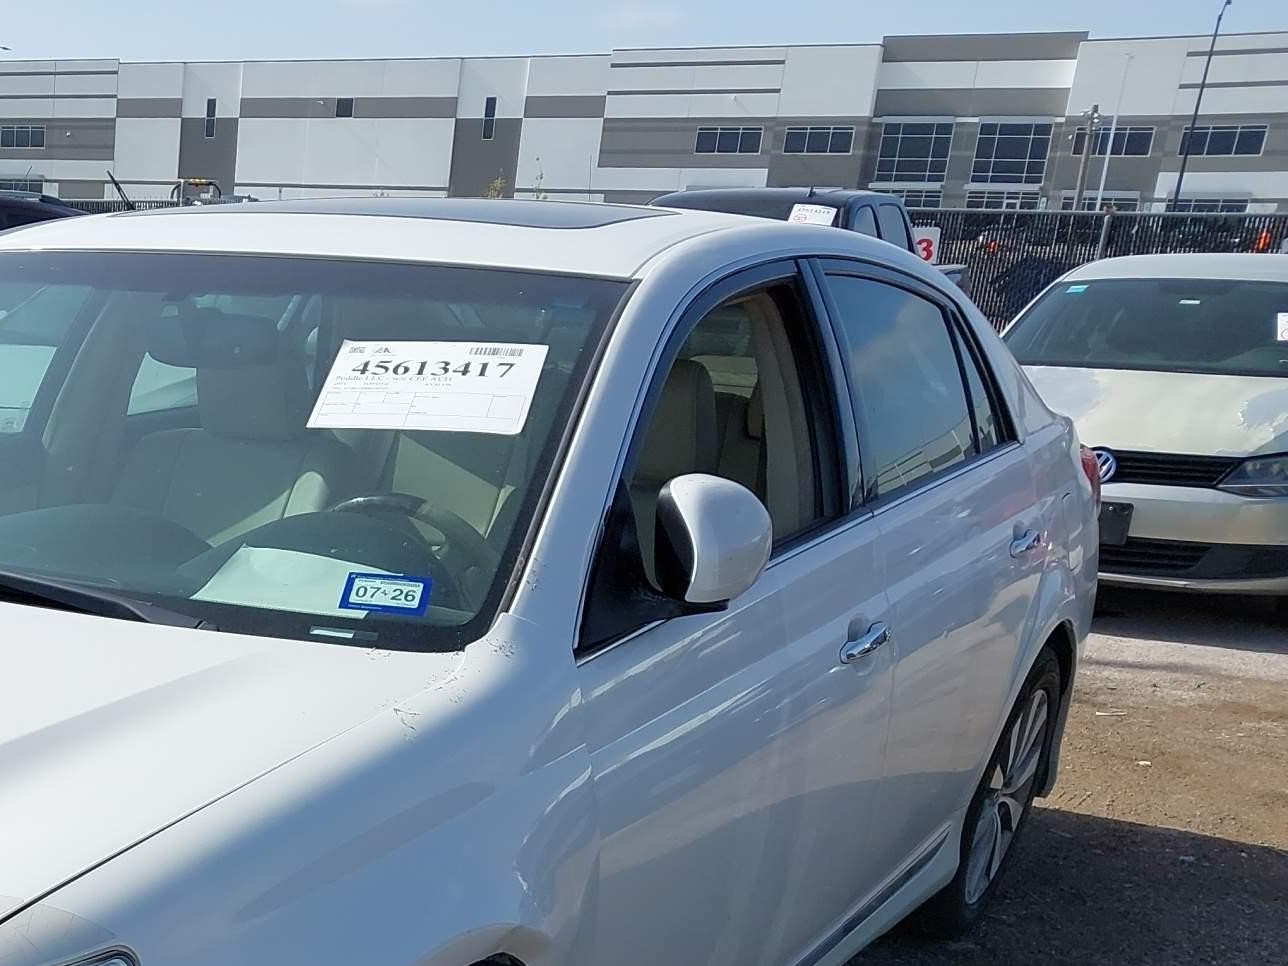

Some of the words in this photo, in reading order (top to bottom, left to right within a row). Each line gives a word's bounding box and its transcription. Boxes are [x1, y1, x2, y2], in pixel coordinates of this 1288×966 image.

[916, 238, 934, 262] 3
[352, 359, 516, 379] 45613417
[355, 586, 382, 599] 07
[390, 588, 417, 602] 26
